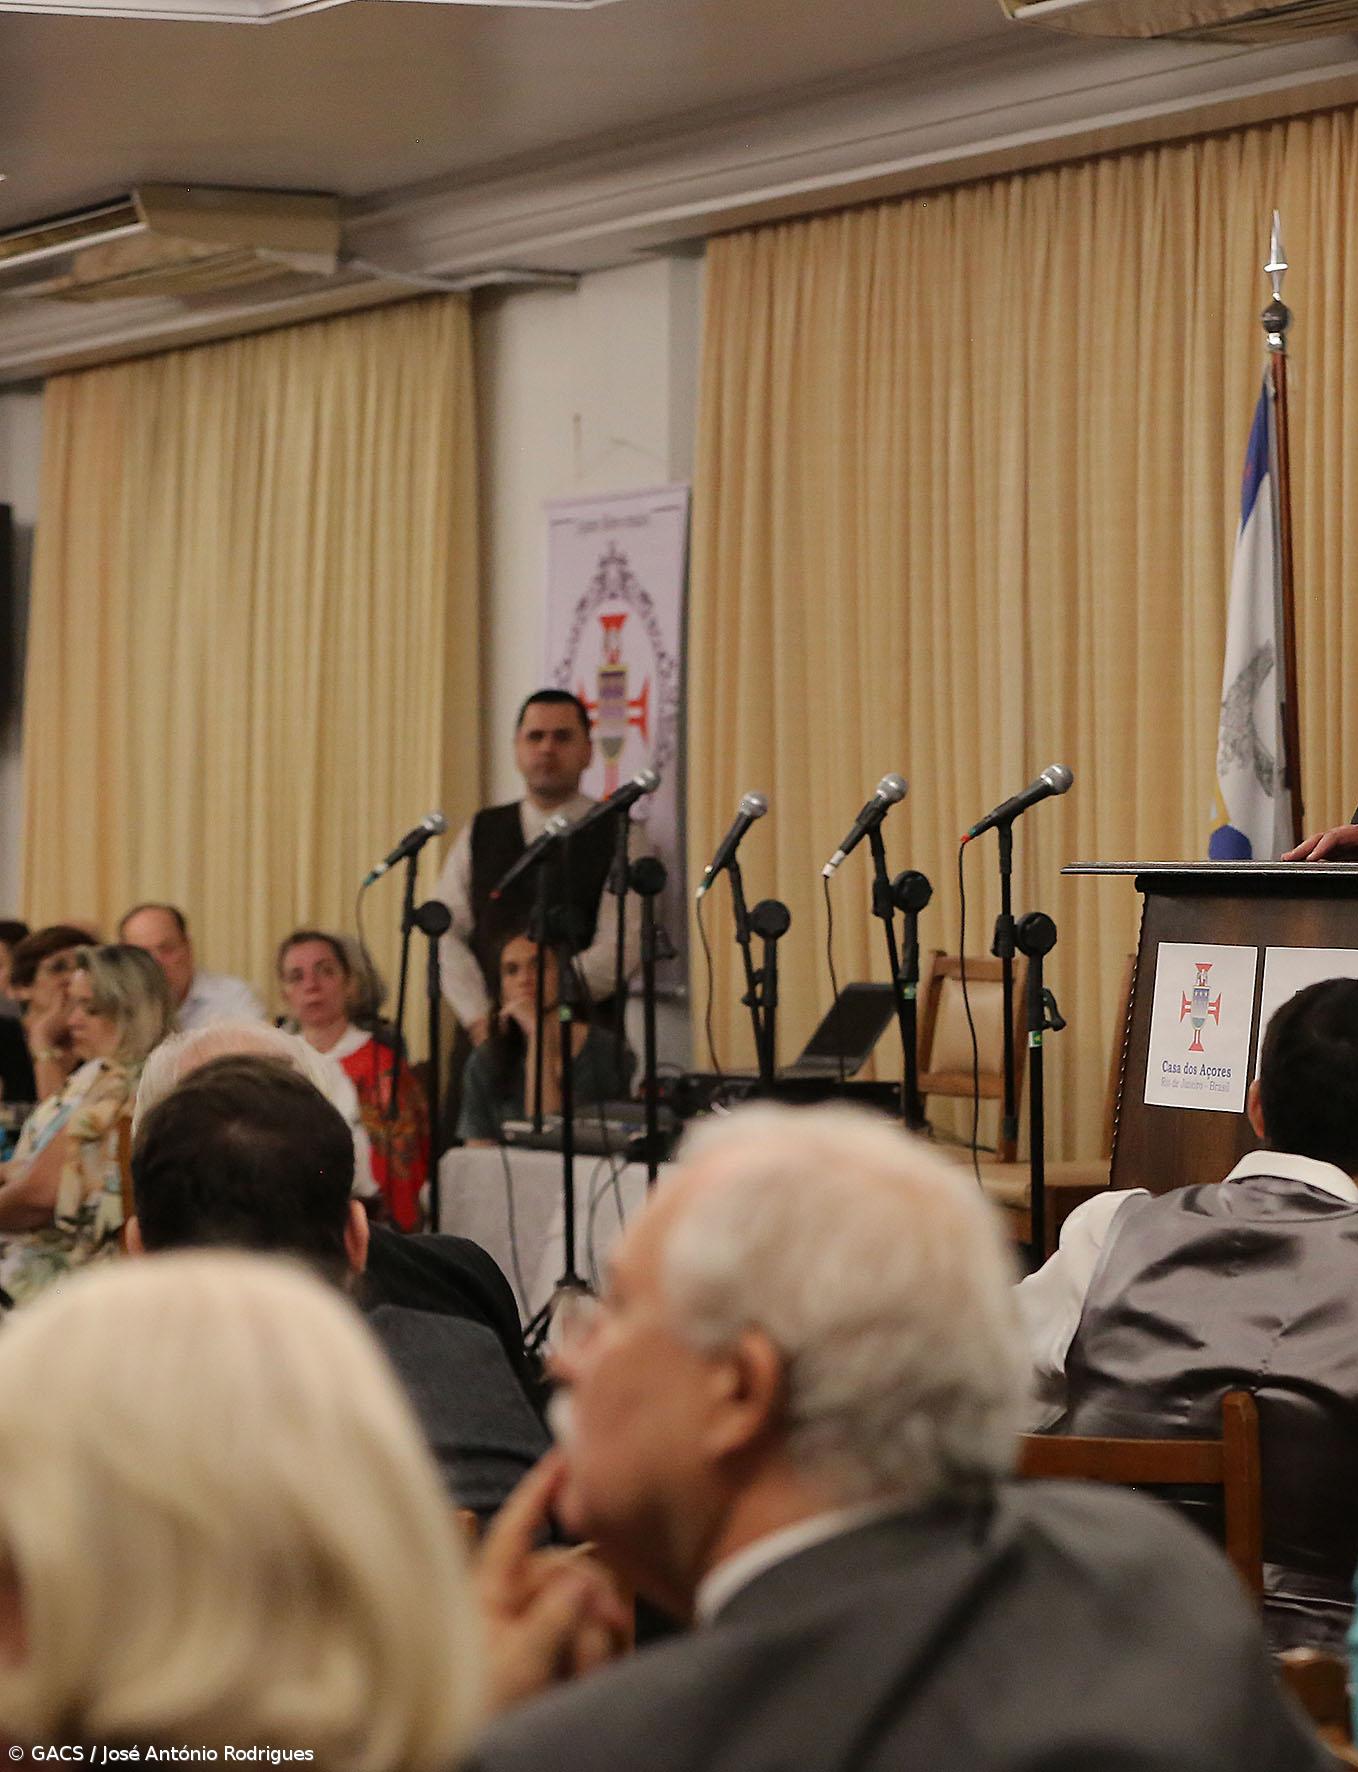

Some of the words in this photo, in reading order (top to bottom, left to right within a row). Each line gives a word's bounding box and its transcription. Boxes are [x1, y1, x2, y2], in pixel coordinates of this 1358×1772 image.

[1162, 1060, 1181, 1074] Casa
[1184, 1062, 1197, 1075] dos
[1200, 1064, 1232, 1079] Açores
